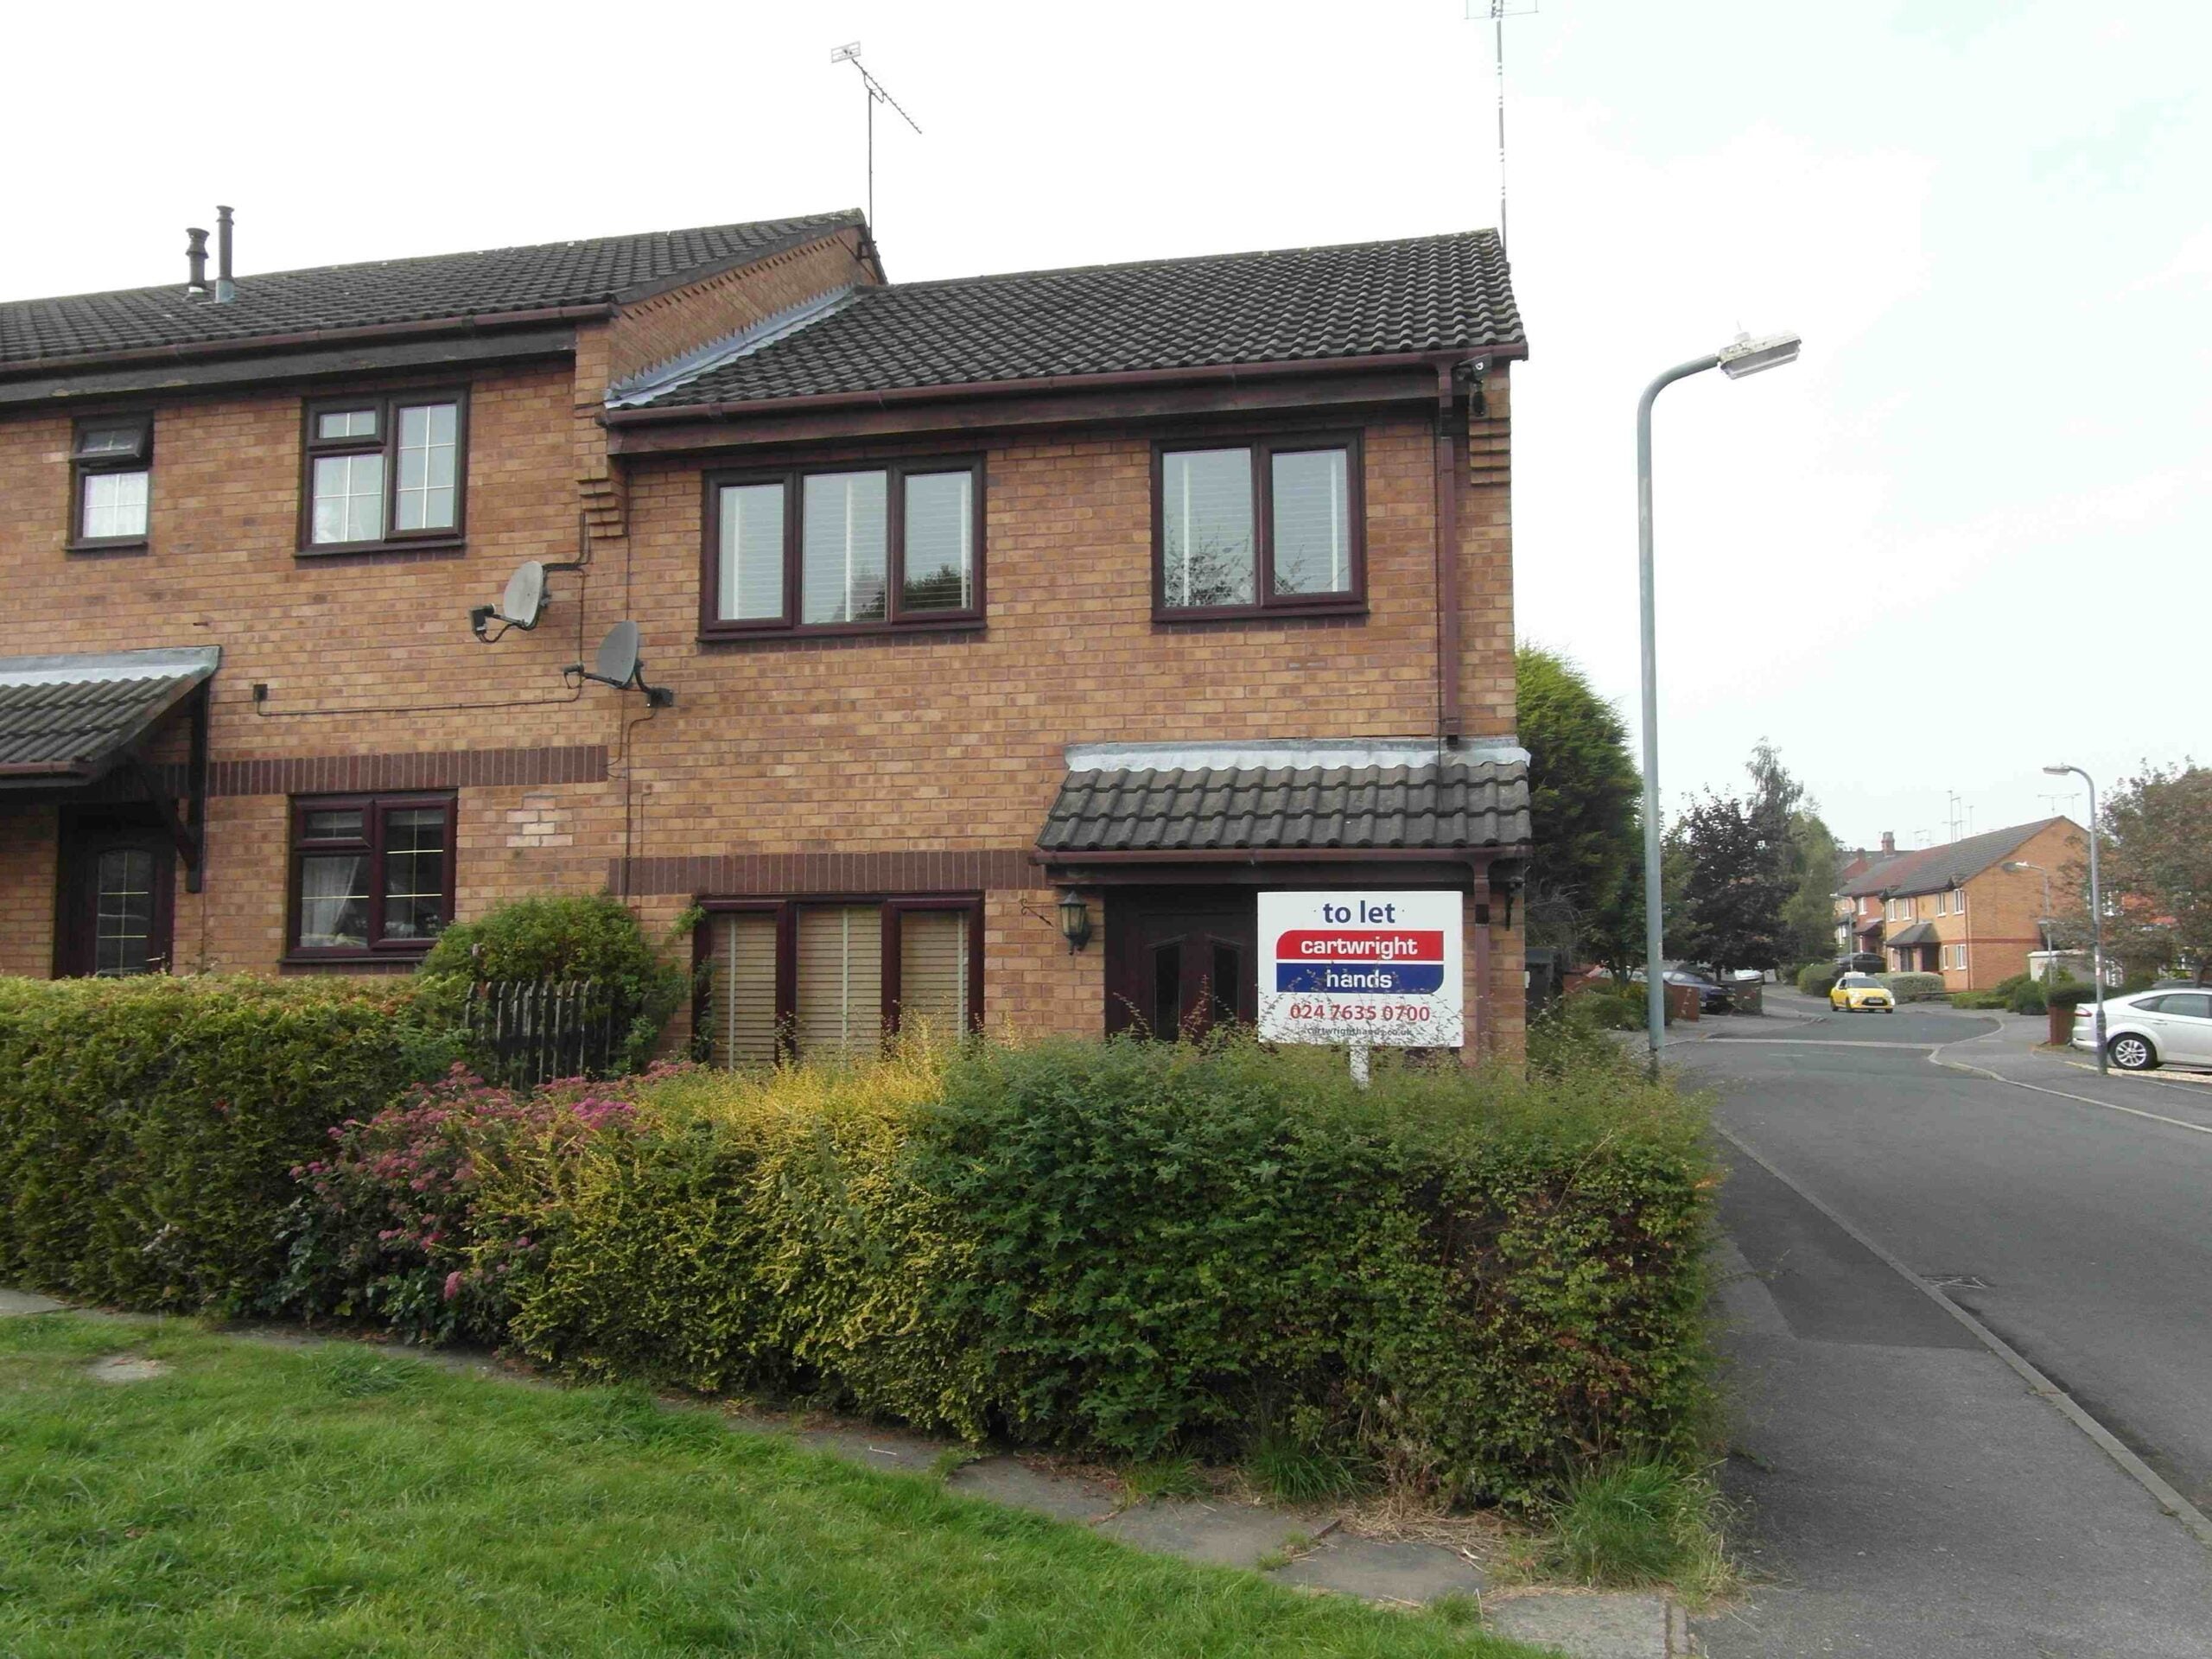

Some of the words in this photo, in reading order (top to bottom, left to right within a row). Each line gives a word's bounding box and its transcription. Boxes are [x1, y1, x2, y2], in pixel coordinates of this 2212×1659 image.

[1323, 903, 1351, 924] to
[1360, 900, 1395, 924] let
[1300, 936, 1418, 959] cartwright
[1326, 969, 1393, 988] hands
[1290, 1004, 1325, 1020] 024
[1331, 1005, 1376, 1020] 7635
[1382, 1006, 1430, 1021] 0700
